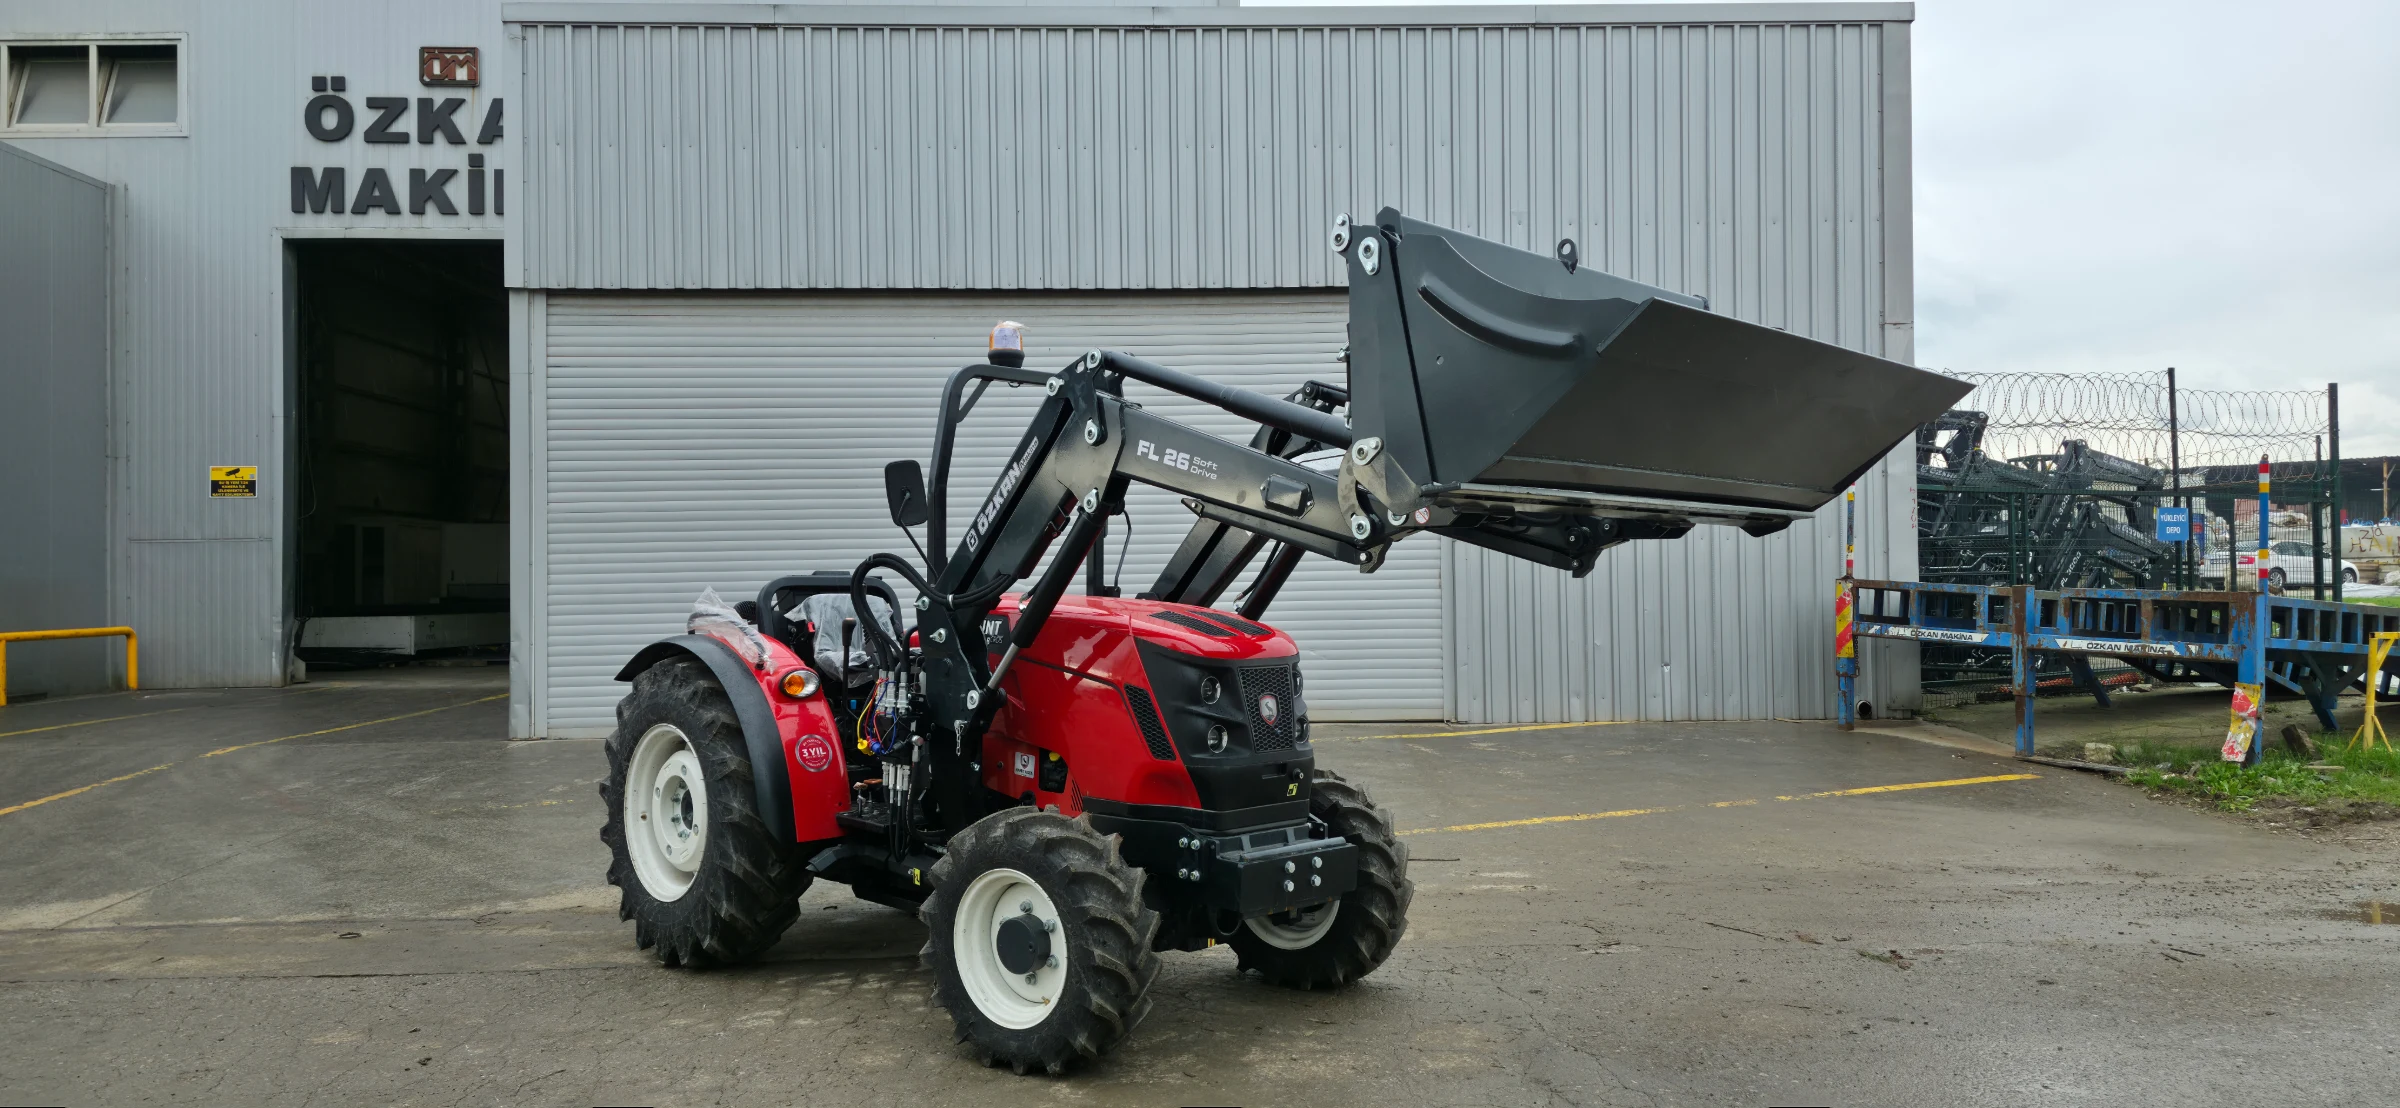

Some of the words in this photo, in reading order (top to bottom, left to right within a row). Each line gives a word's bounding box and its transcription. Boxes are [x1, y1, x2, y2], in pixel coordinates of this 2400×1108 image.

[1137, 439, 1159, 461] FL
[1163, 448, 1190, 471] 26
[1193, 456, 1218, 470] Soft
[1190, 465, 1217, 480] Drive
[978, 461, 1020, 536] ÖZKAN
[2166, 526, 2181, 534] DEPO
[801, 748, 809, 757] 3
[809, 747, 827, 756] YIL
